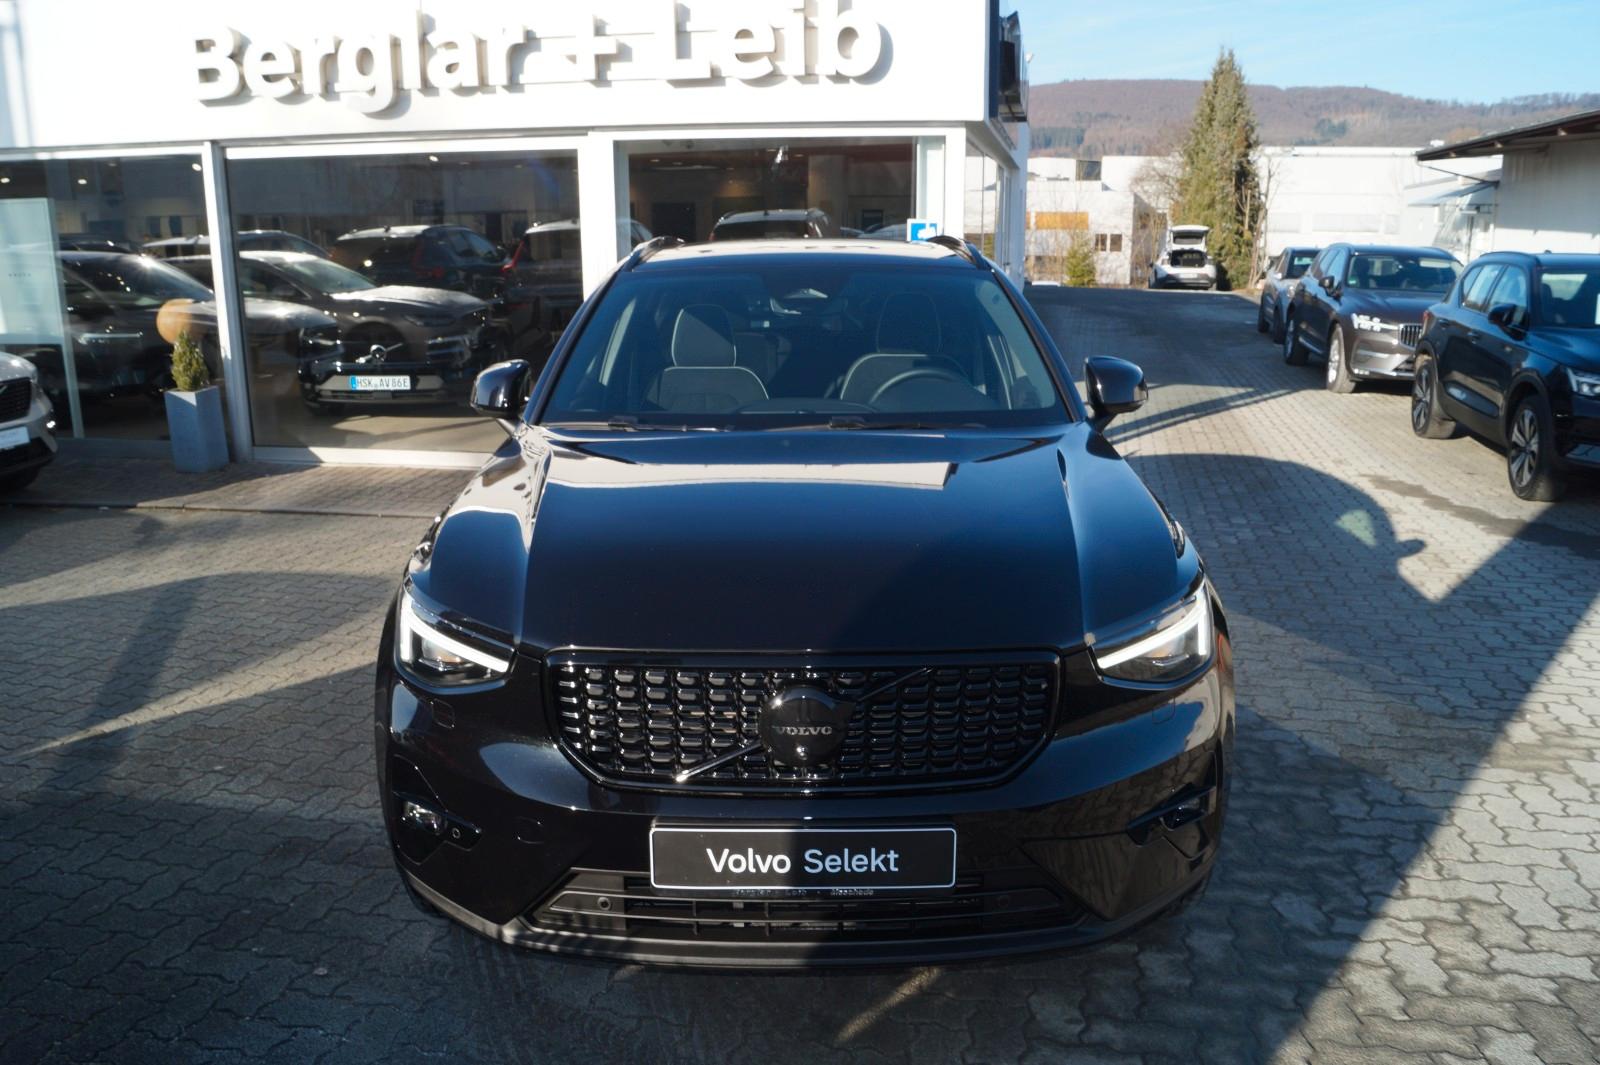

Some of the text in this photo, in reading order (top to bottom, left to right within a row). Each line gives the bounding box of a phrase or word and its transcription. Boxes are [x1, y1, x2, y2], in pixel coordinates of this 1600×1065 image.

[193, 4, 534, 118] Berglar
[658, 0, 889, 84] Leib
[772, 725, 833, 736] VOLVO
[706, 848, 899, 873] Volvo Selekt
